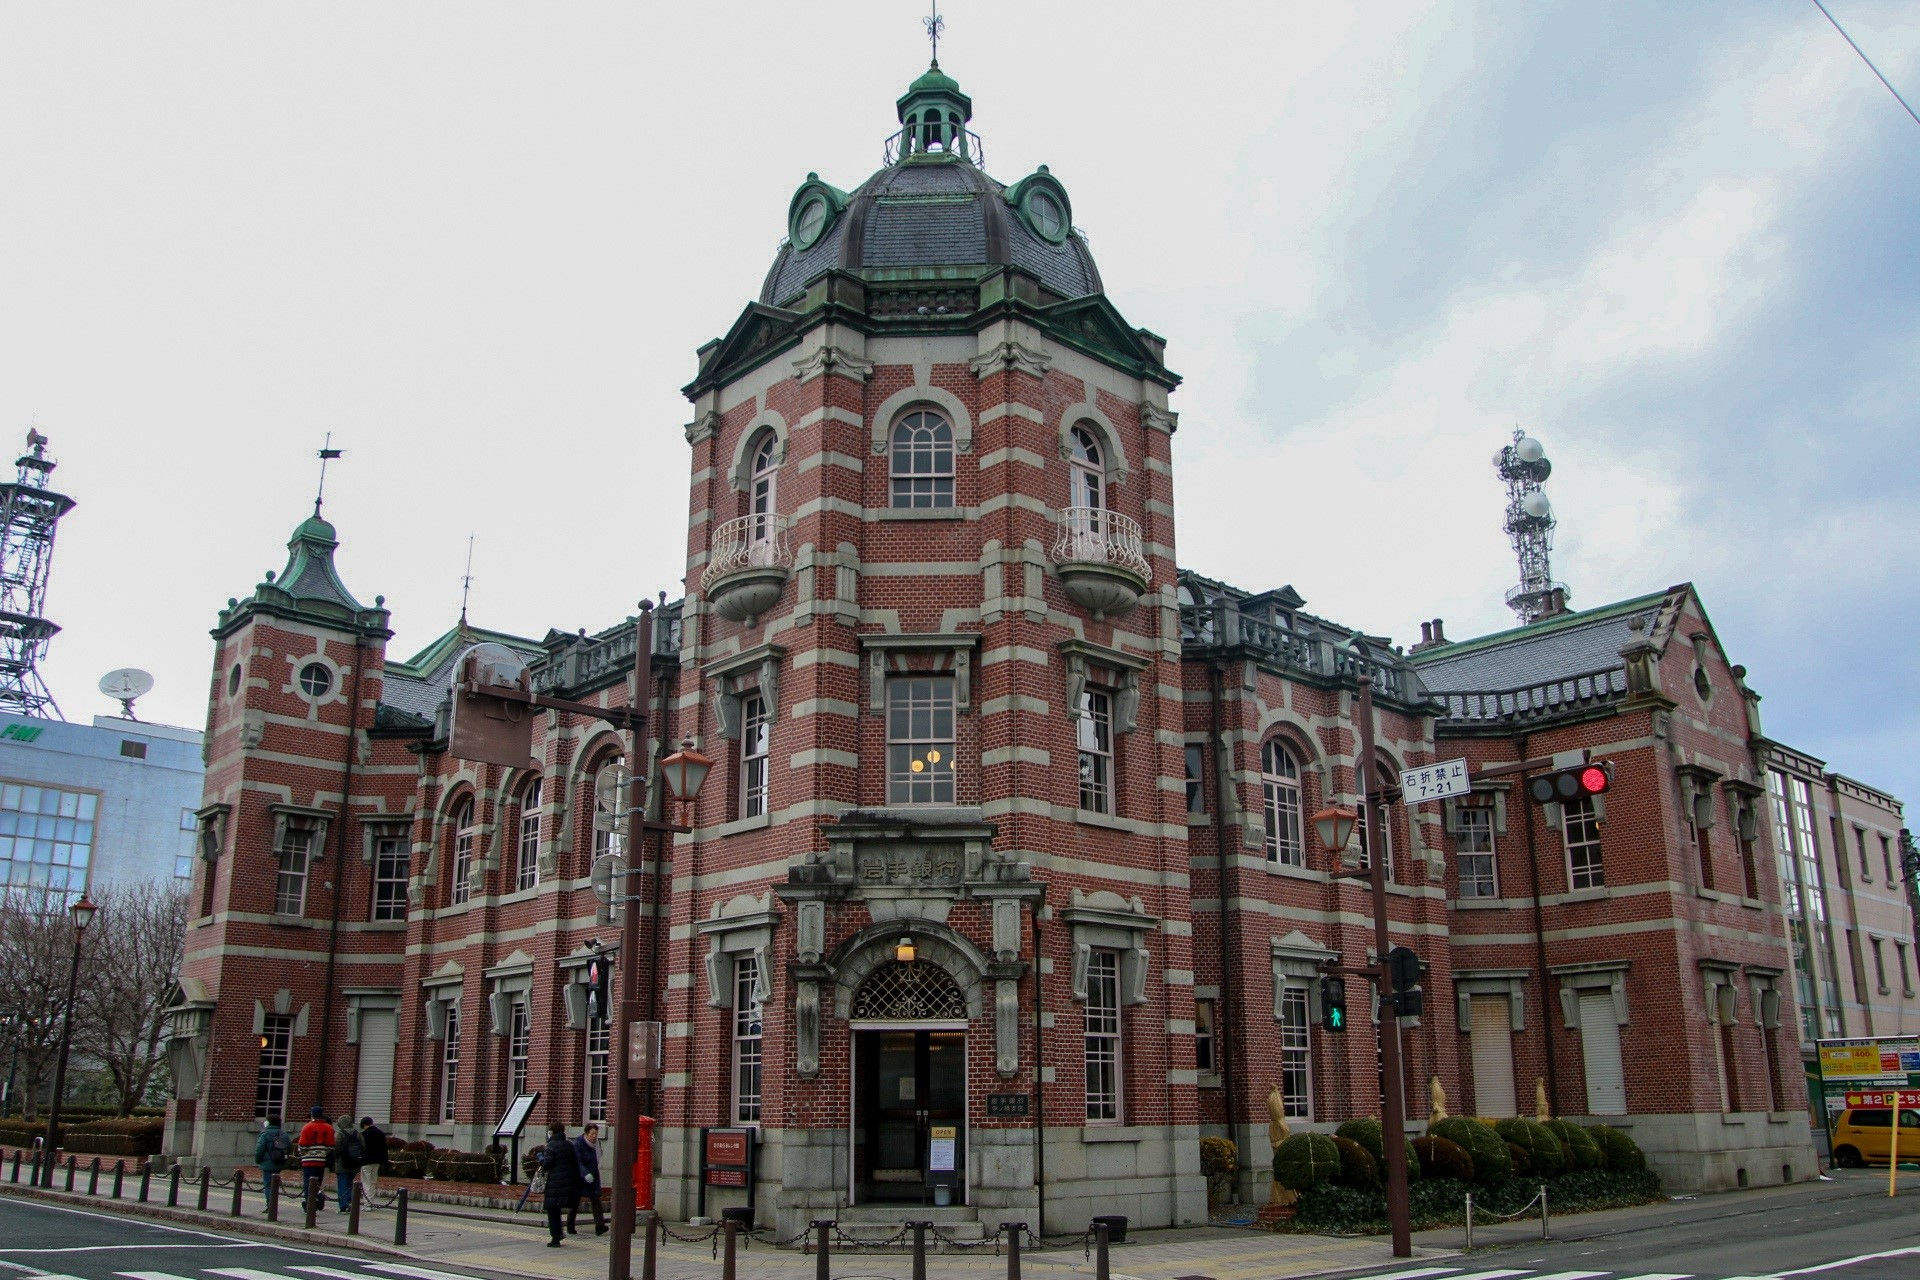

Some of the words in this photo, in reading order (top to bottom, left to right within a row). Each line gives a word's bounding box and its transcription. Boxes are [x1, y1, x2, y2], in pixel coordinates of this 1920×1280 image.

[1405, 765, 1462, 787] 右折禁止
[1420, 782, 1452, 796] 7-21
[863, 859, 957, 879] 岩手銀行
